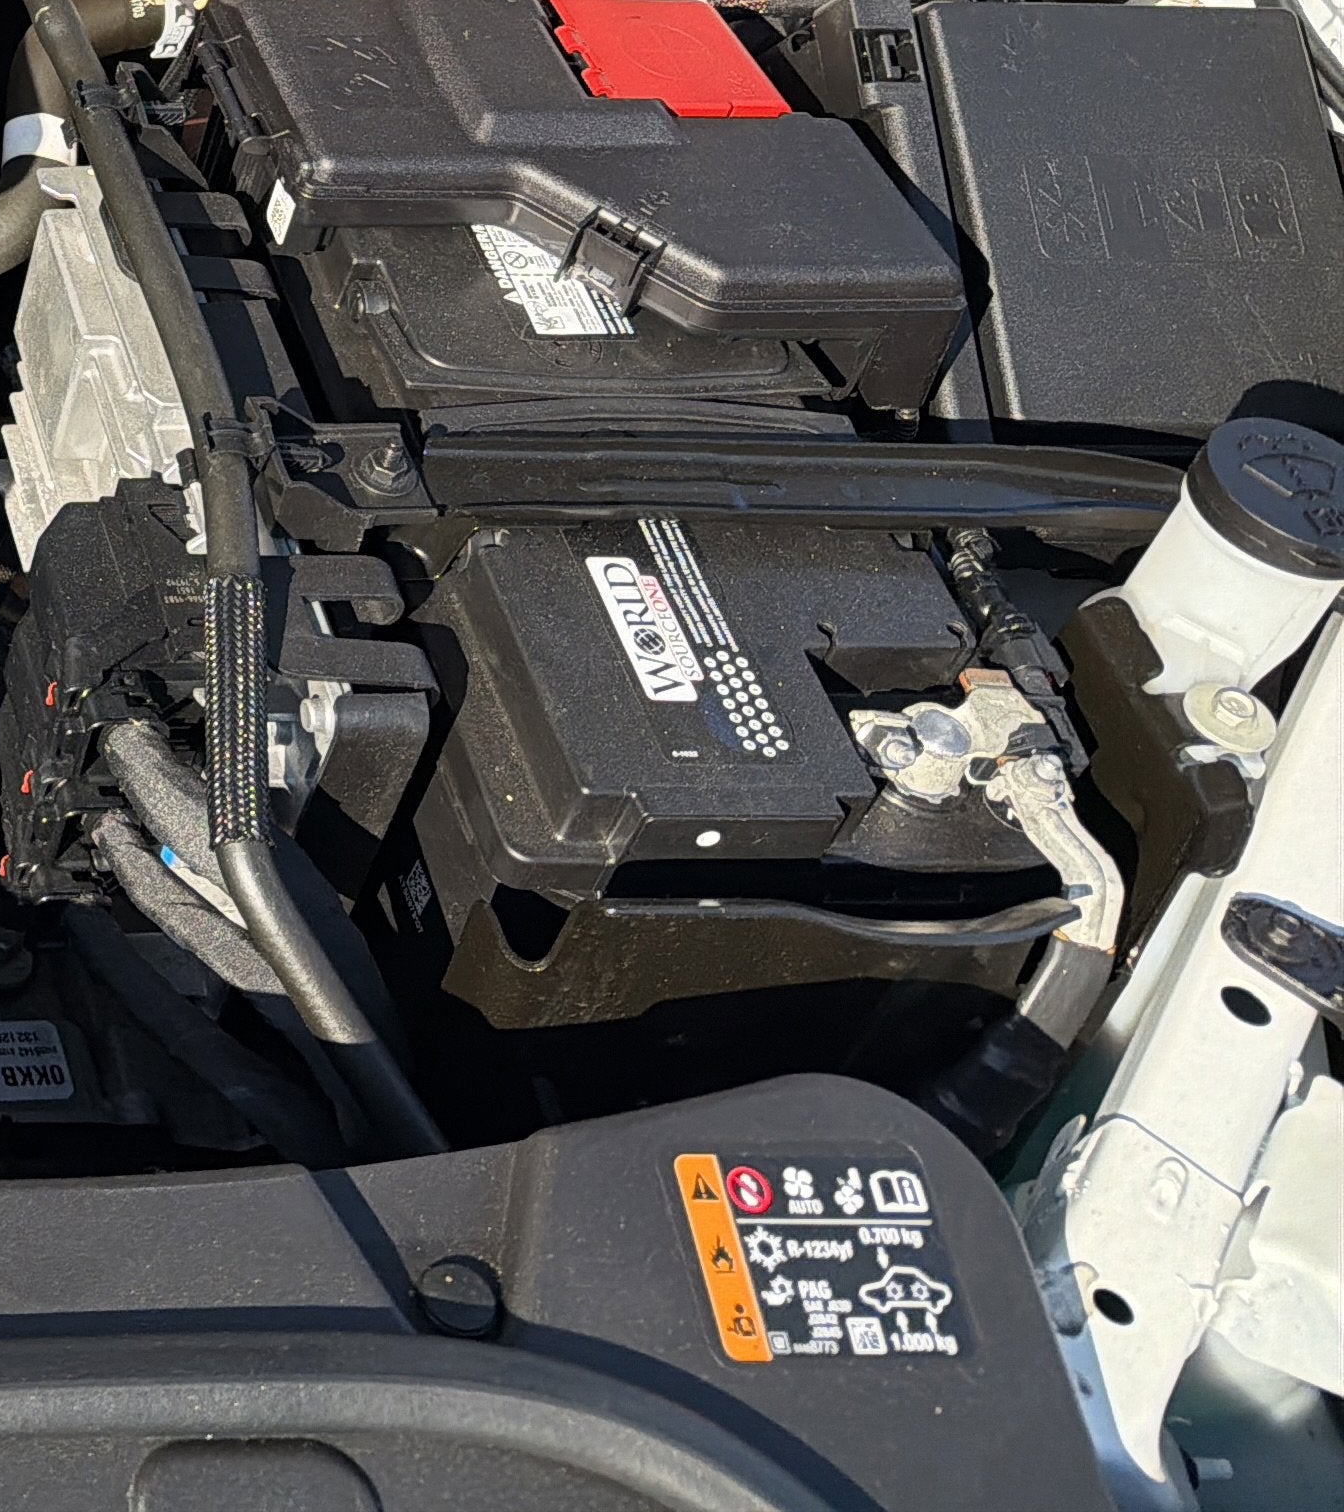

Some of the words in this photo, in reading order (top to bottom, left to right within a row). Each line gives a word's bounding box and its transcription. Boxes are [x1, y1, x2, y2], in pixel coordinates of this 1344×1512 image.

[788, 1199, 824, 1215] AUTO
[858, 1227, 901, 1245] 0.700
[900, 1227, 925, 1249] kg
[786, 1239, 855, 1262] R-1234yf
[797, 1279, 833, 1299] PAG
[889, 1332, 934, 1353] 1.000
[934, 1334, 959, 1356] kg
